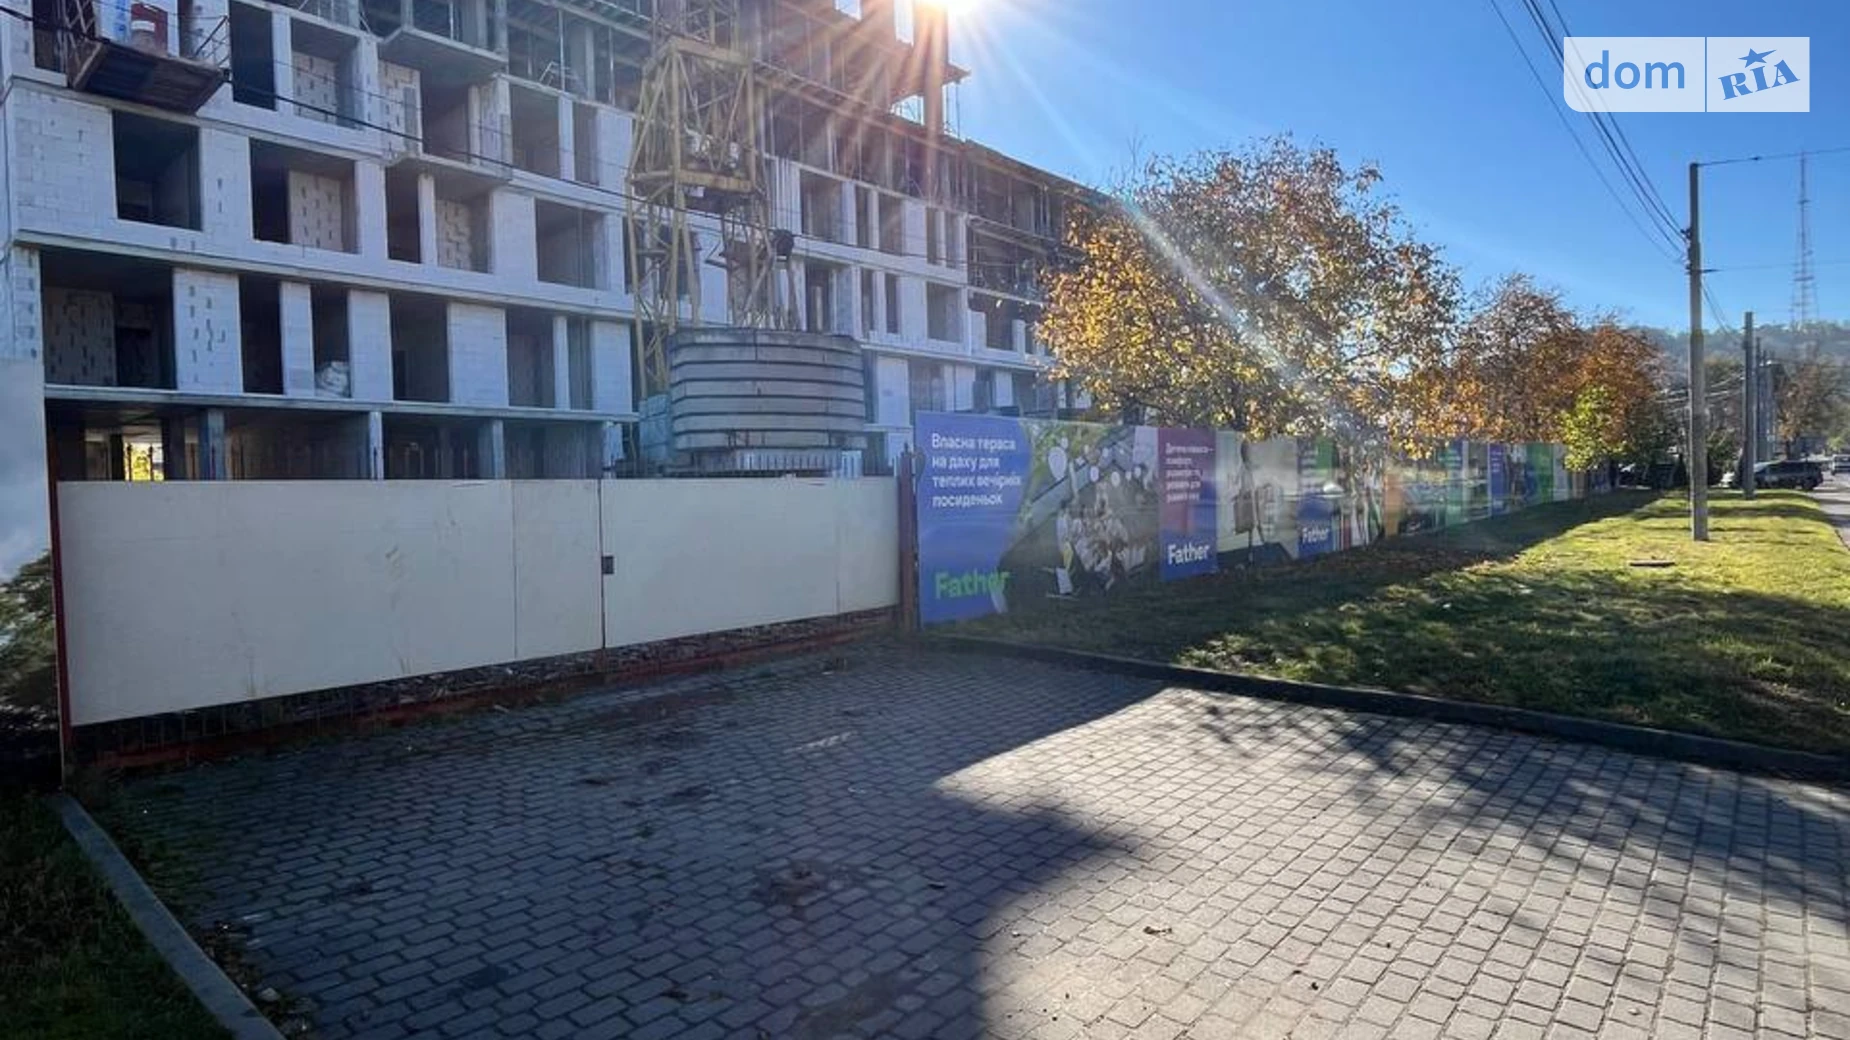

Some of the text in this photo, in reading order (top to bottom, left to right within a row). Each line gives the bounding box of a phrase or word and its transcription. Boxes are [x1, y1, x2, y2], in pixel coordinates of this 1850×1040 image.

[932, 432, 1016, 453] Власна тераса
[932, 456, 1000, 473] на даху для
[932, 475, 976, 489] теплих
[932, 493, 1003, 508] посиденьок
[1168, 541, 1210, 565] Father
[934, 567, 1011, 600] Father
